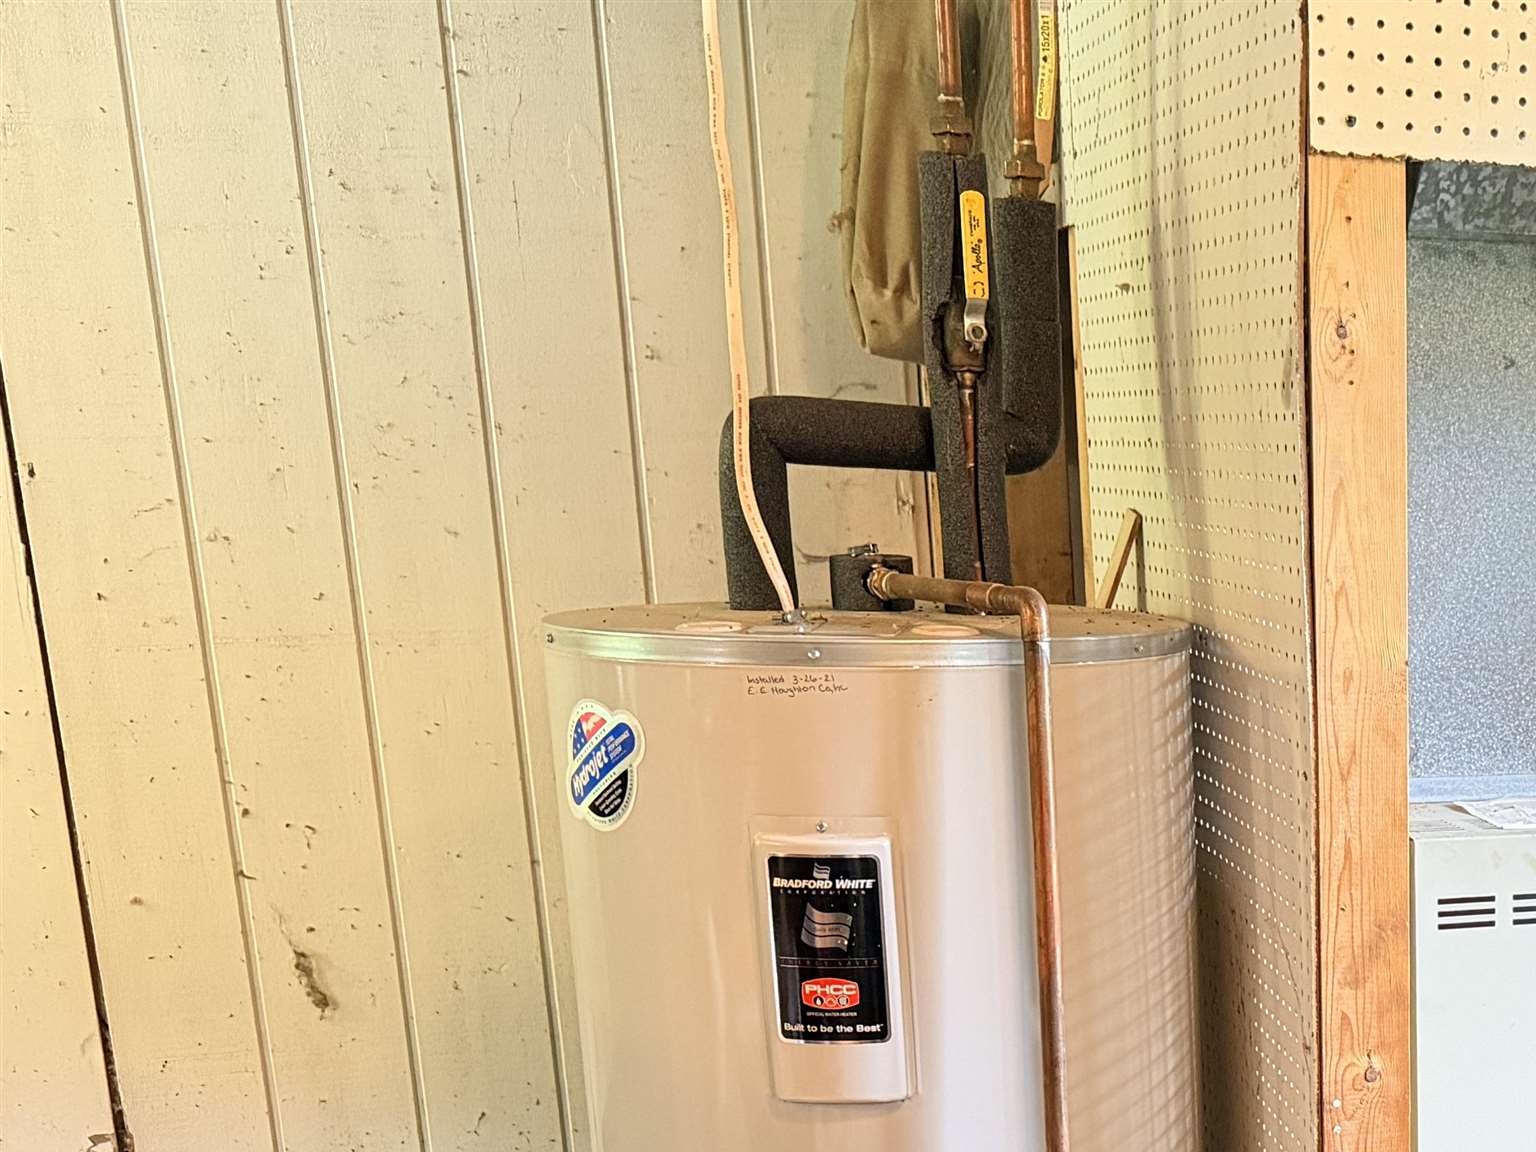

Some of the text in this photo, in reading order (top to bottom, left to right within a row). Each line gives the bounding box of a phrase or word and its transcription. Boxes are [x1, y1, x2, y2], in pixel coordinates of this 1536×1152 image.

[1041, 14, 1050, 52] 15x20x1
[572, 744, 609, 797] Hydrojet
[772, 877, 875, 889] BRADFORD WHITE
[804, 984, 857, 995] PHCC
[784, 1022, 805, 1032] Built
[807, 1023, 818, 1032] to
[820, 1024, 833, 1033] be
[836, 1024, 853, 1033] the
